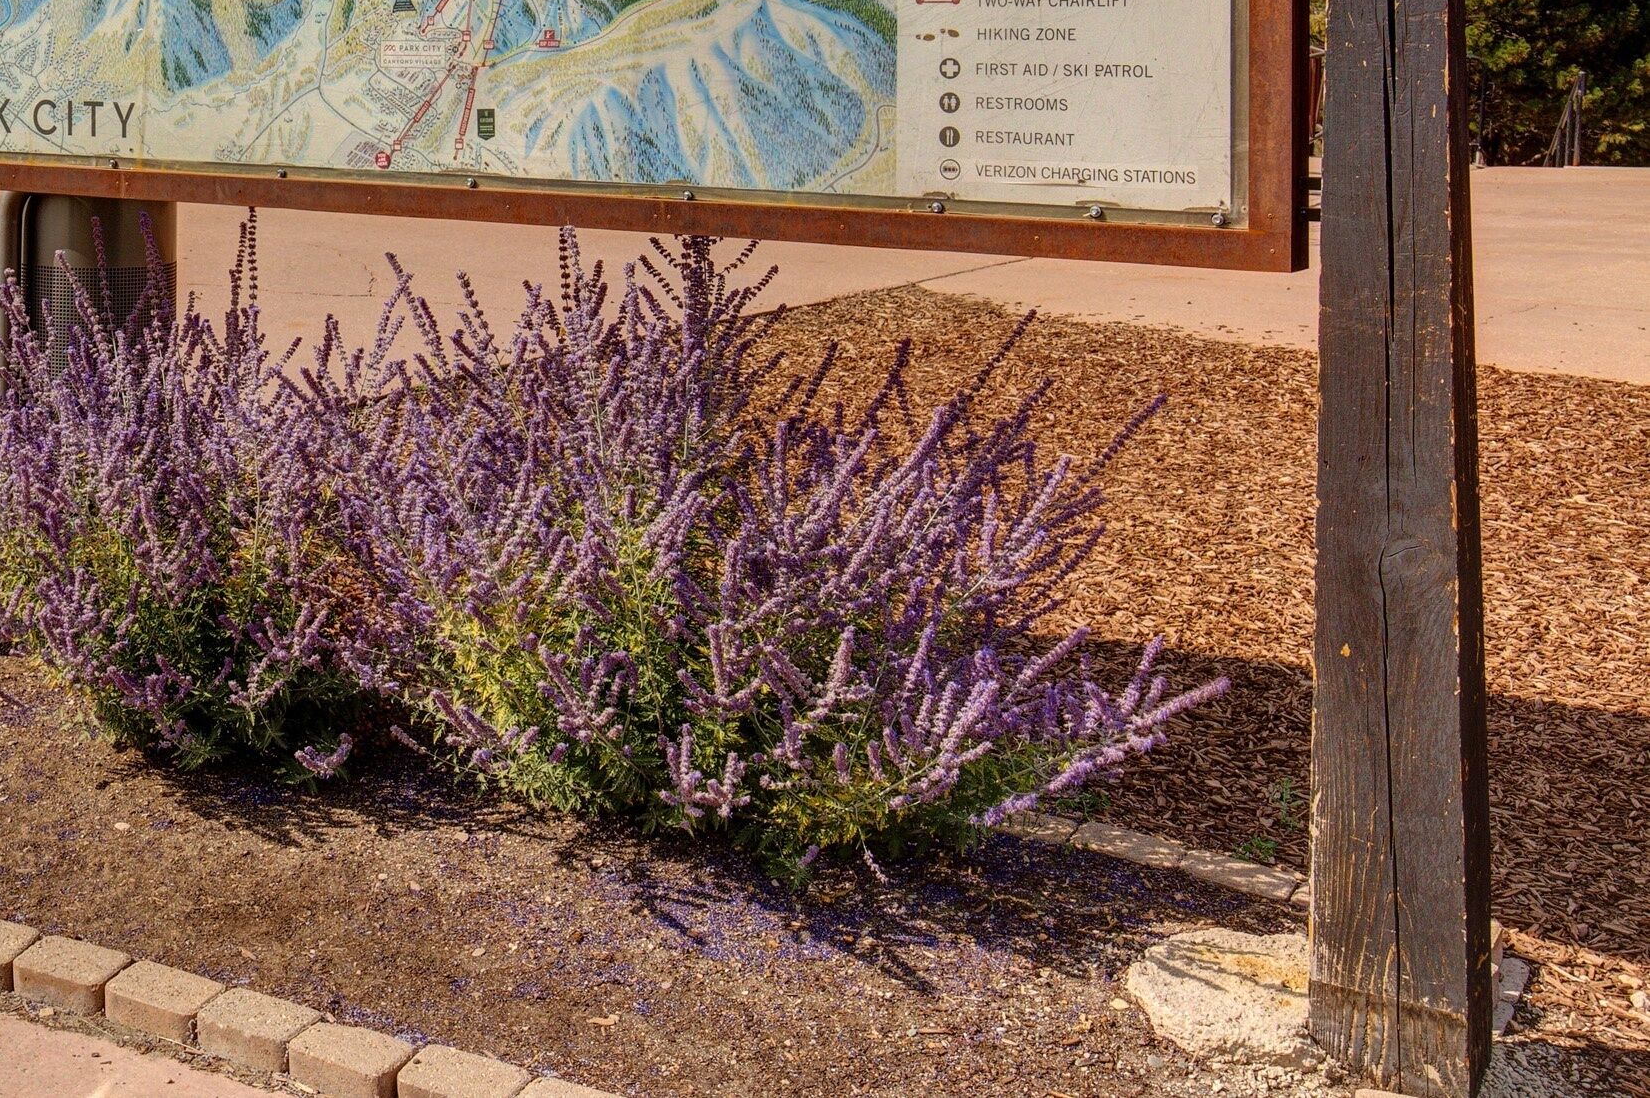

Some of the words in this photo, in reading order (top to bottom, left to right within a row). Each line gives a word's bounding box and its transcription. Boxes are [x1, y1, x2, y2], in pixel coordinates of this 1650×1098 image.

[978, 28, 1030, 40] HIKING
[1036, 28, 1076, 41] ZONE
[976, 63, 1018, 75] FIRST
[1023, 64, 1048, 76] AID
[1063, 64, 1087, 76] SKI
[1095, 65, 1153, 78] PATROL
[976, 97, 1068, 111] RESTROOMS
[33, 98, 136, 139] CITY
[976, 131, 1075, 146] RESTAURANT
[976, 165, 1036, 178] VERIZON
[1041, 167, 1118, 184] CHARGING
[1124, 170, 1195, 184] STATIONS
